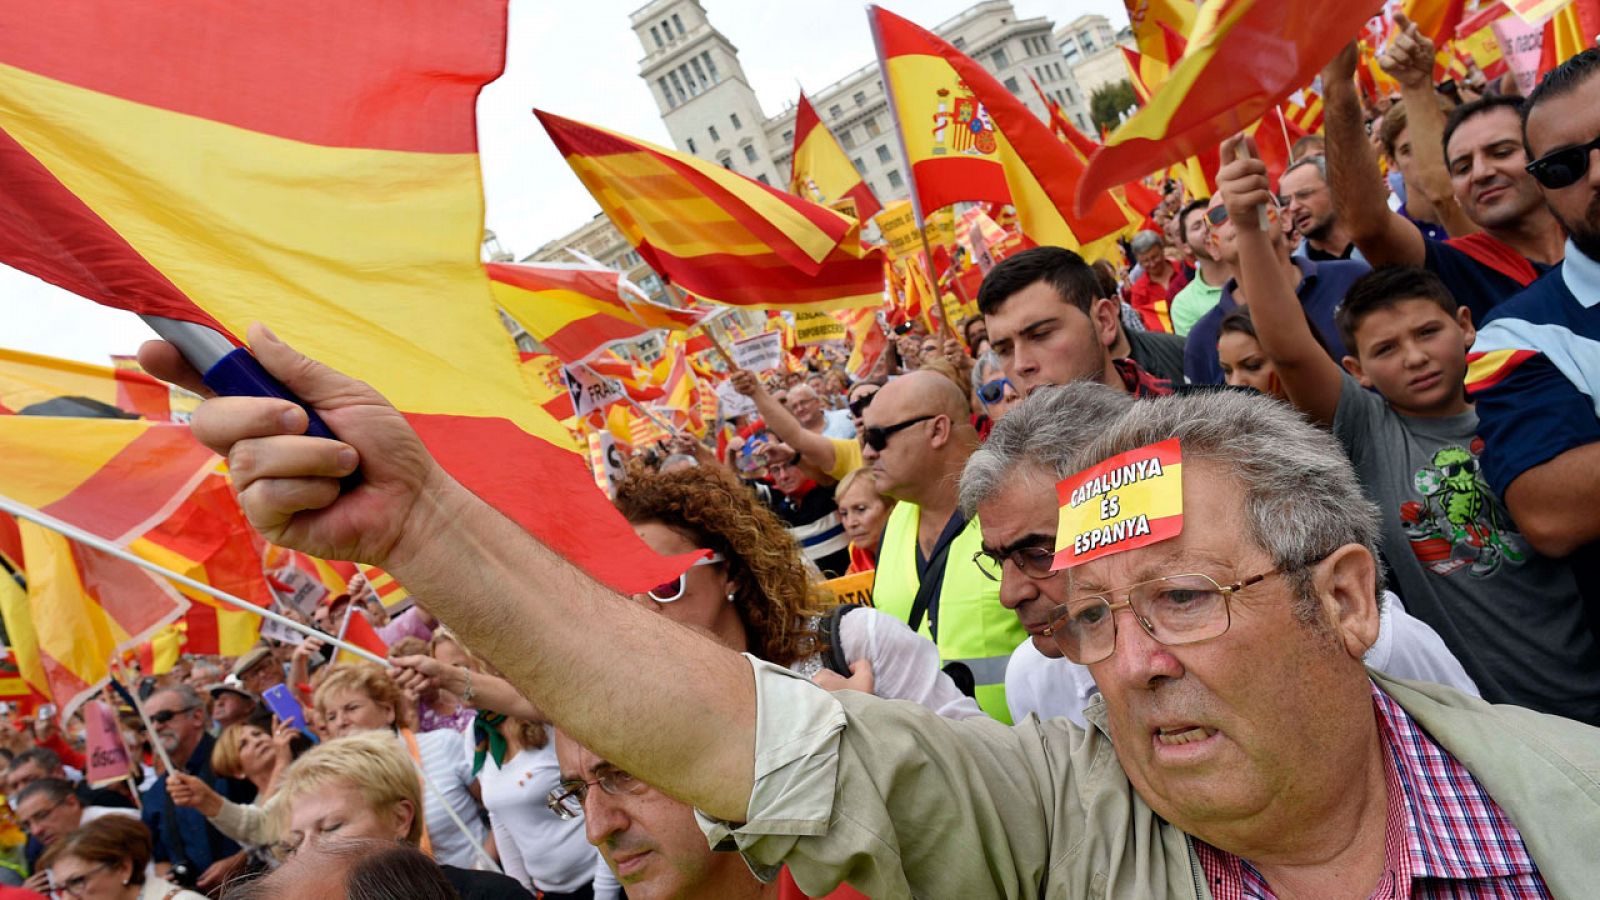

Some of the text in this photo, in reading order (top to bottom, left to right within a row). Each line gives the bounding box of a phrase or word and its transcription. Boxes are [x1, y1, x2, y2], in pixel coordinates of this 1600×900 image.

[1070, 457, 1163, 508] CATALUNYA
[1099, 492, 1121, 520] ÉS
[1073, 514, 1152, 557] ESPANYA
